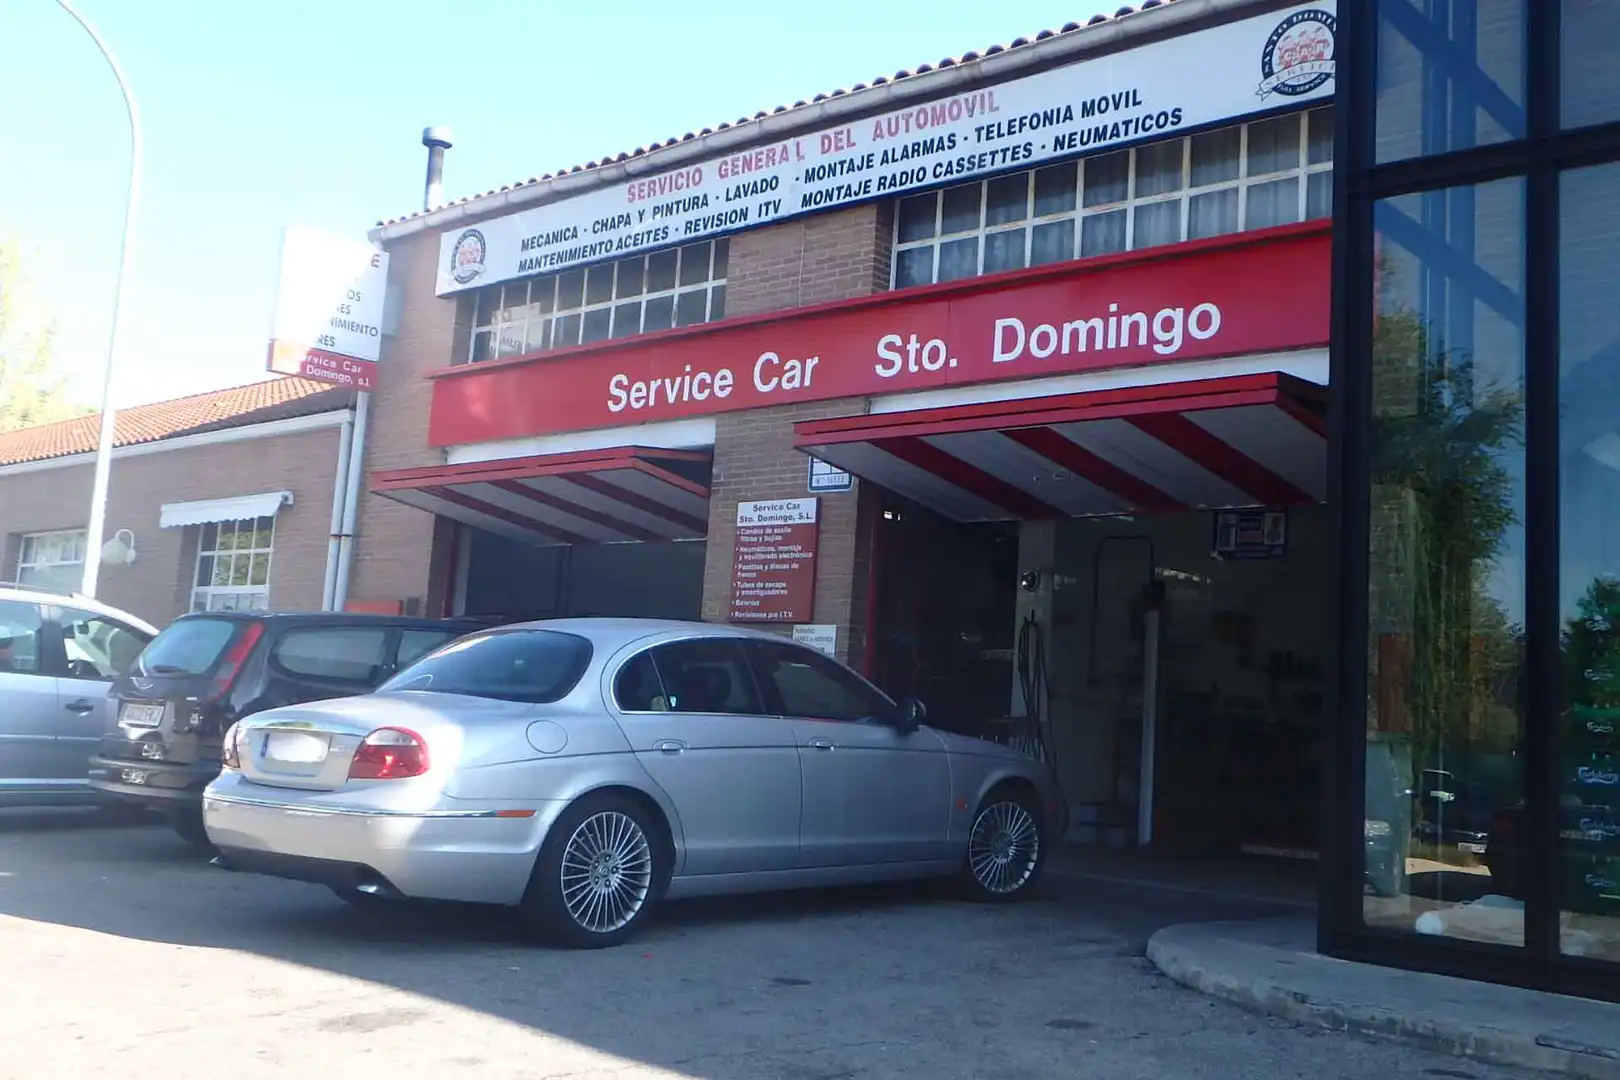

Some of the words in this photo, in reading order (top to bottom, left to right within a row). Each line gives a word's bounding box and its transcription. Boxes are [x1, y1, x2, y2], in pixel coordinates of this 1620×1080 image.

[517, 240, 613, 274] MANTENIMIENTO
[616, 226, 669, 251] ACEITES
[684, 207, 749, 235] REVISION
[757, 198, 782, 218] ITV
[800, 179, 872, 209] MONTAJE
[876, 166, 927, 193] RADIO
[932, 141, 1034, 181] CASSETTES
[1052, 106, 1183, 153] NEUMATICOS
[520, 225, 578, 253] MECANICA
[592, 213, 632, 235] CHAPA
[637, 208, 646, 224] Y
[652, 193, 709, 221] PINTURA
[725, 175, 779, 203] LAVADO
[804, 153, 875, 185] MONTAJE
[880, 133, 957, 166] ALARMAS
[975, 105, 1074, 144] TELEFONIA
[1081, 88, 1143, 118] MOVIL
[627, 166, 703, 204] SERVICIO
[718, 140, 805, 180] GENERAL
[820, 130, 856, 156] DEL
[872, 89, 1000, 139] AUTOMOVIL
[343, 359, 363, 374] Car
[606, 363, 735, 413] Service
[753, 352, 820, 394] Car
[875, 334, 958, 378] Sto.
[992, 301, 1222, 364] Domingo
[752, 503, 784, 512] Service
[786, 502, 801, 510] Car
